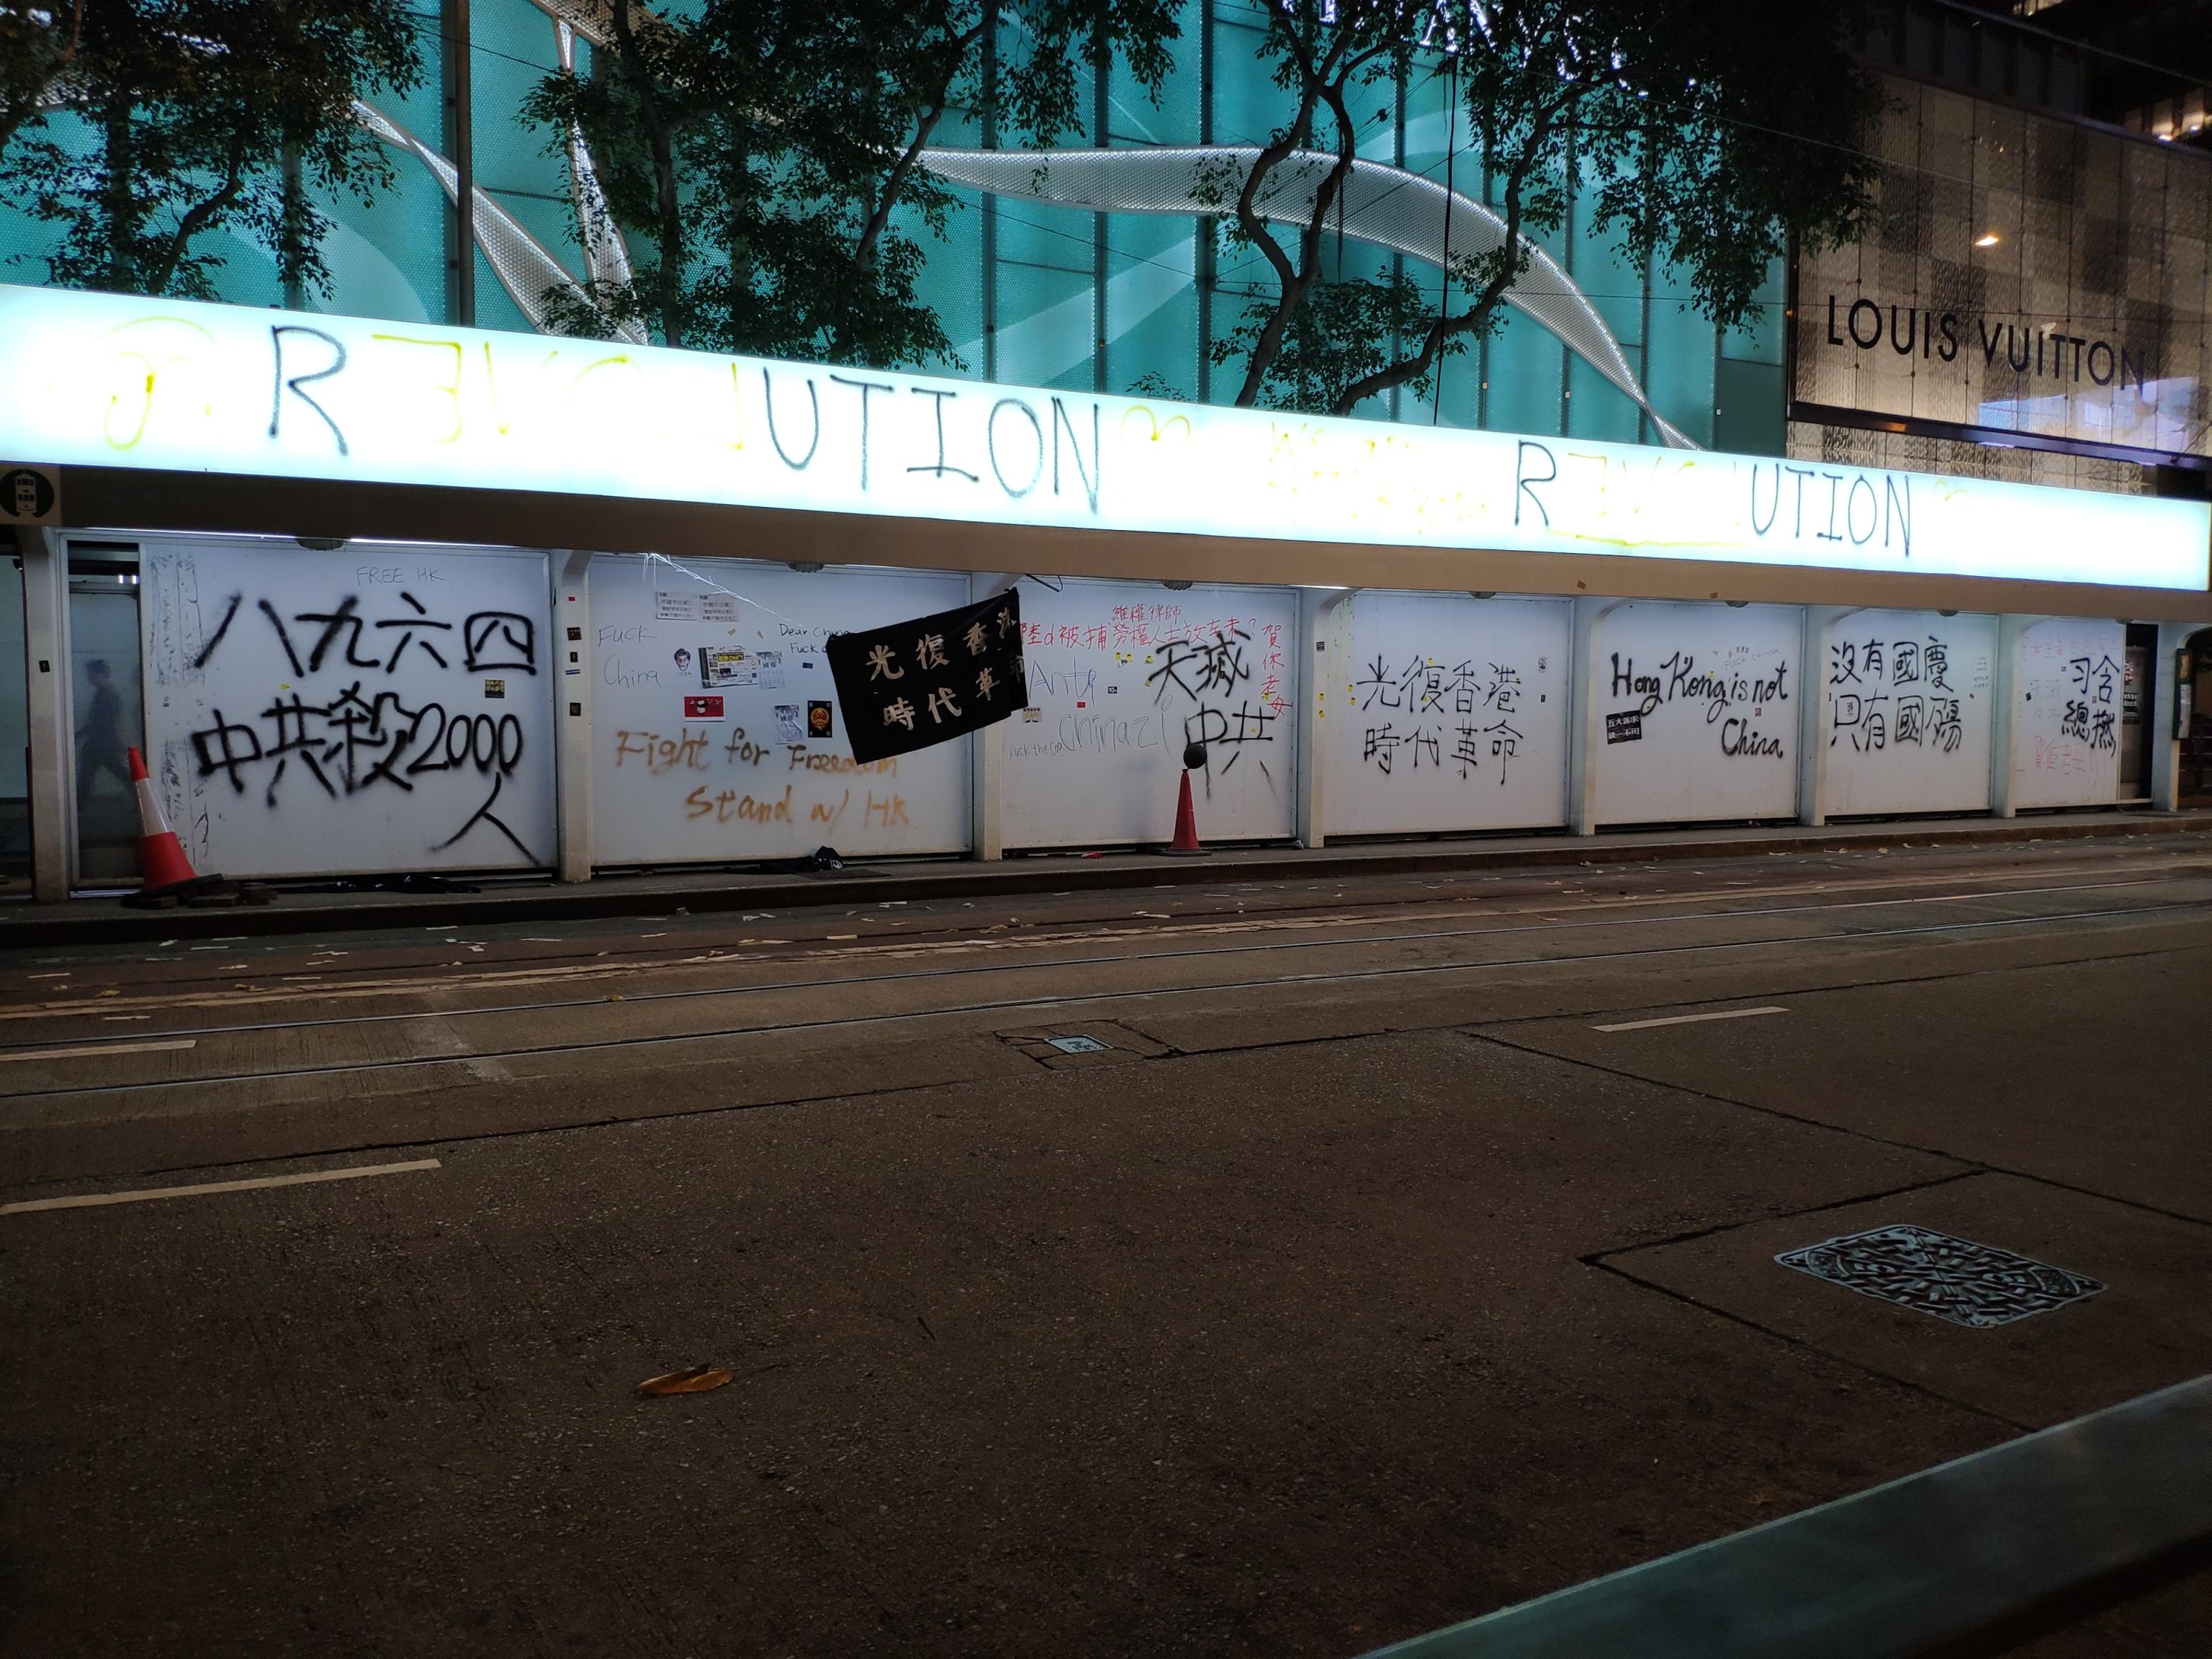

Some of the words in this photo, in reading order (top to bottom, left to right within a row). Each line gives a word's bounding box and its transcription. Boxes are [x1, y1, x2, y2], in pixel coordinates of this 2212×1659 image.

[1827, 294, 1958, 361] LOUIS
[1978, 318, 2146, 392] VUITTON
[356, 566, 404, 585] FREE
[416, 566, 445, 583] HK
[194, 591, 538, 678] 八九六四
[779, 623, 808, 637] Dear
[790, 642, 819, 654] Fuck
[603, 652, 662, 689] China
[1356, 653, 1521, 714] 光復香港
[1611, 652, 1663, 717] Hong
[1660, 651, 1730, 724] Kong
[1731, 672, 1748, 701] is
[1752, 660, 1788, 704] not
[617, 727, 710, 775] Fight
[725, 727, 770, 770] for
[1184, 700, 1277, 802] 中共
[1364, 719, 1524, 786] 時代革命
[1722, 718, 1784, 758] China
[431, 771, 541, 866] 人
[685, 783, 793, 825] Stand
[863, 788, 910, 827] HK
